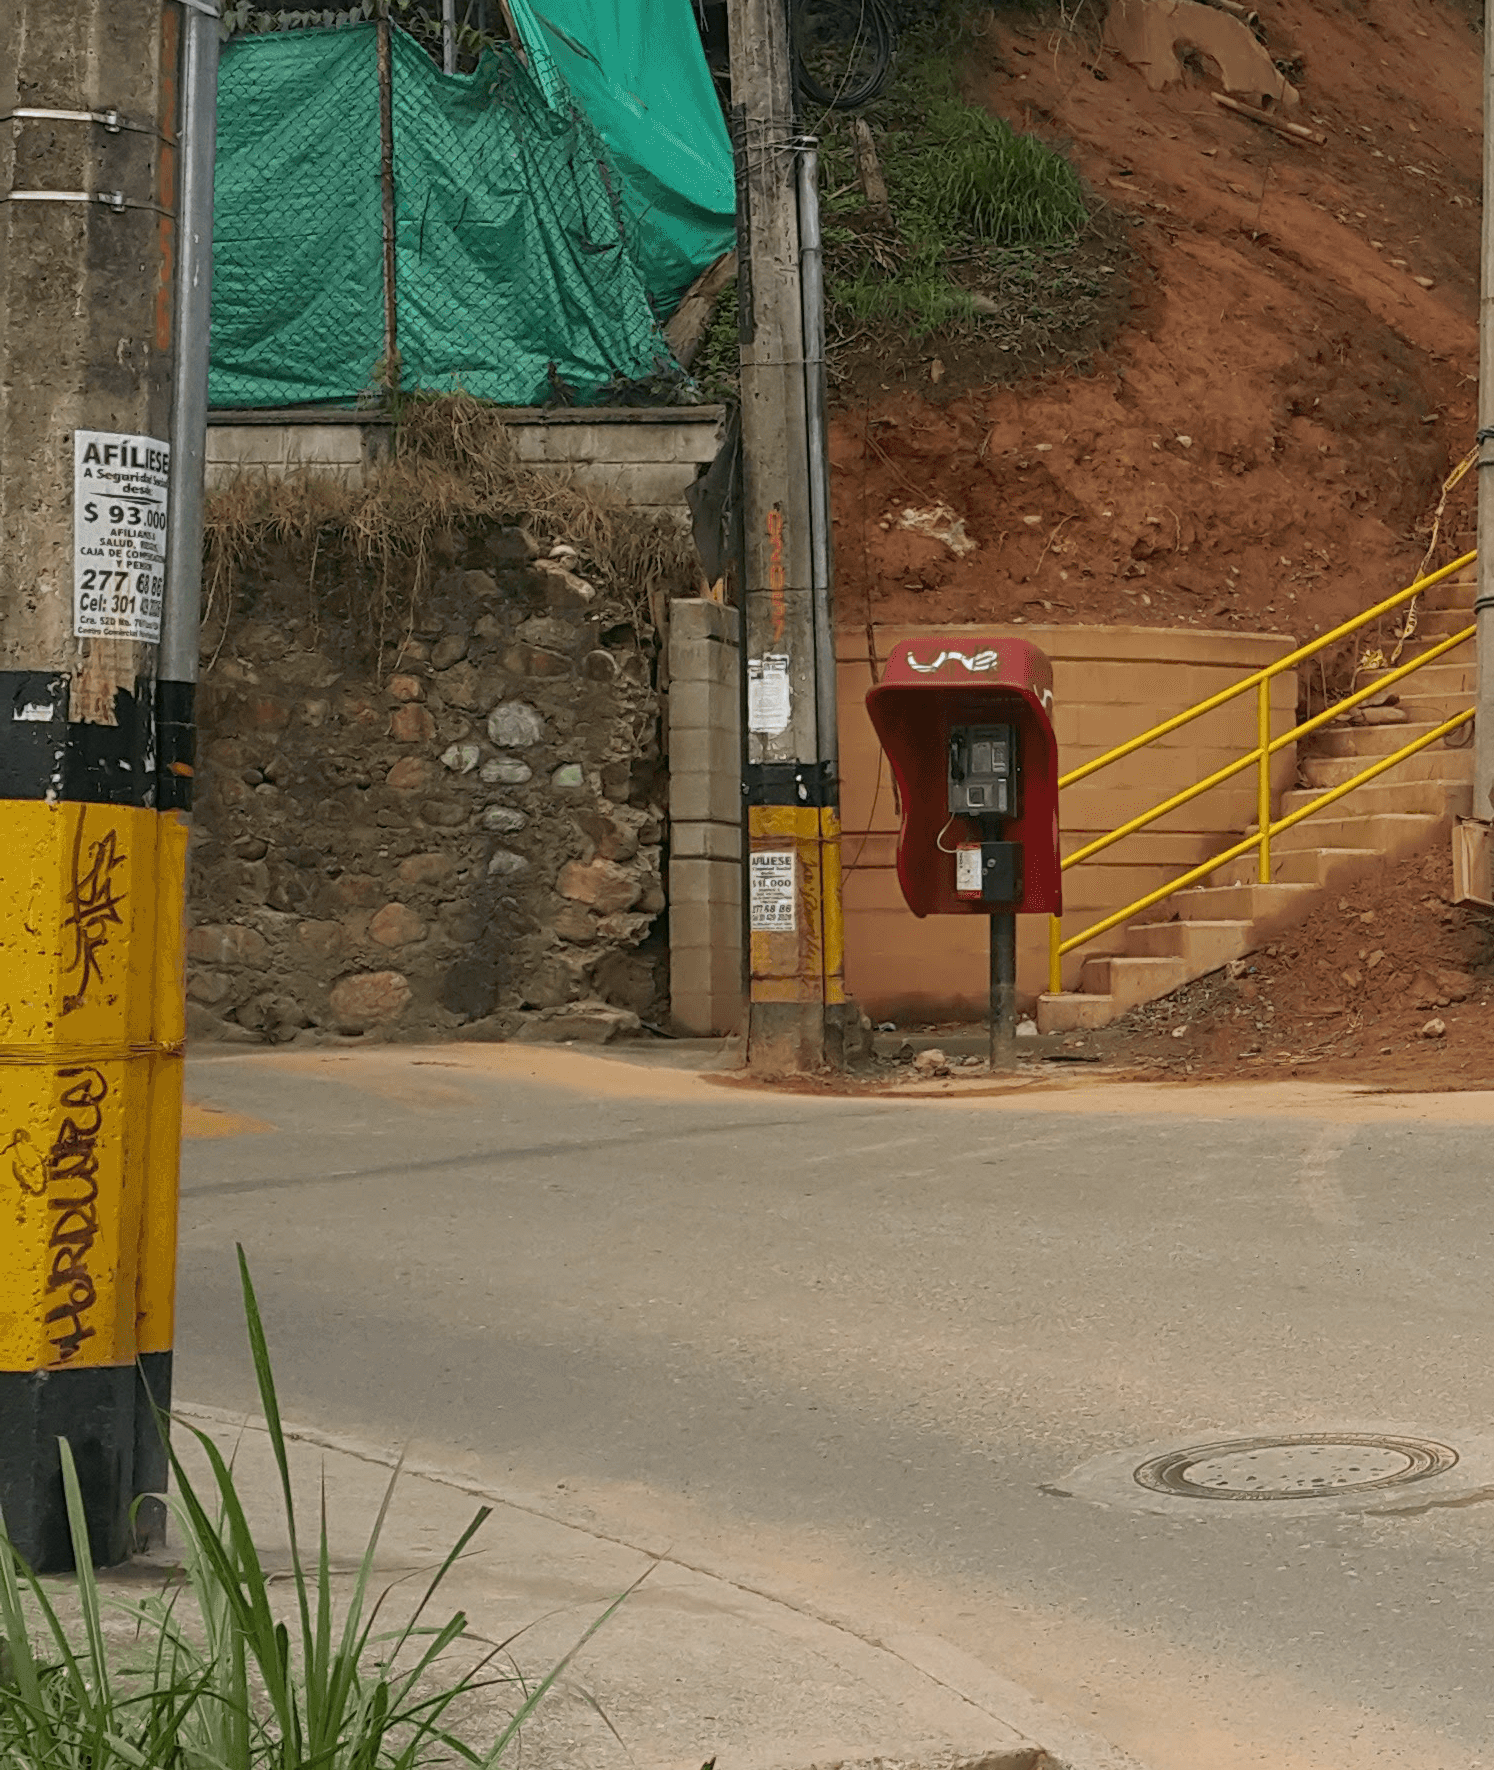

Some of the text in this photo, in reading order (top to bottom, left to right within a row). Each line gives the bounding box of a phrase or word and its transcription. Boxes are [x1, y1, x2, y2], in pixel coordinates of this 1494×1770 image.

[83, 468, 93, 478] A
[84, 502, 166, 531] $ 93.000
[80, 546, 105, 557] CAJA
[108, 549, 122, 558] DE
[81, 569, 129, 592] 277
[80, 592, 107, 612] Cel:
[111, 595, 136, 614] 301
